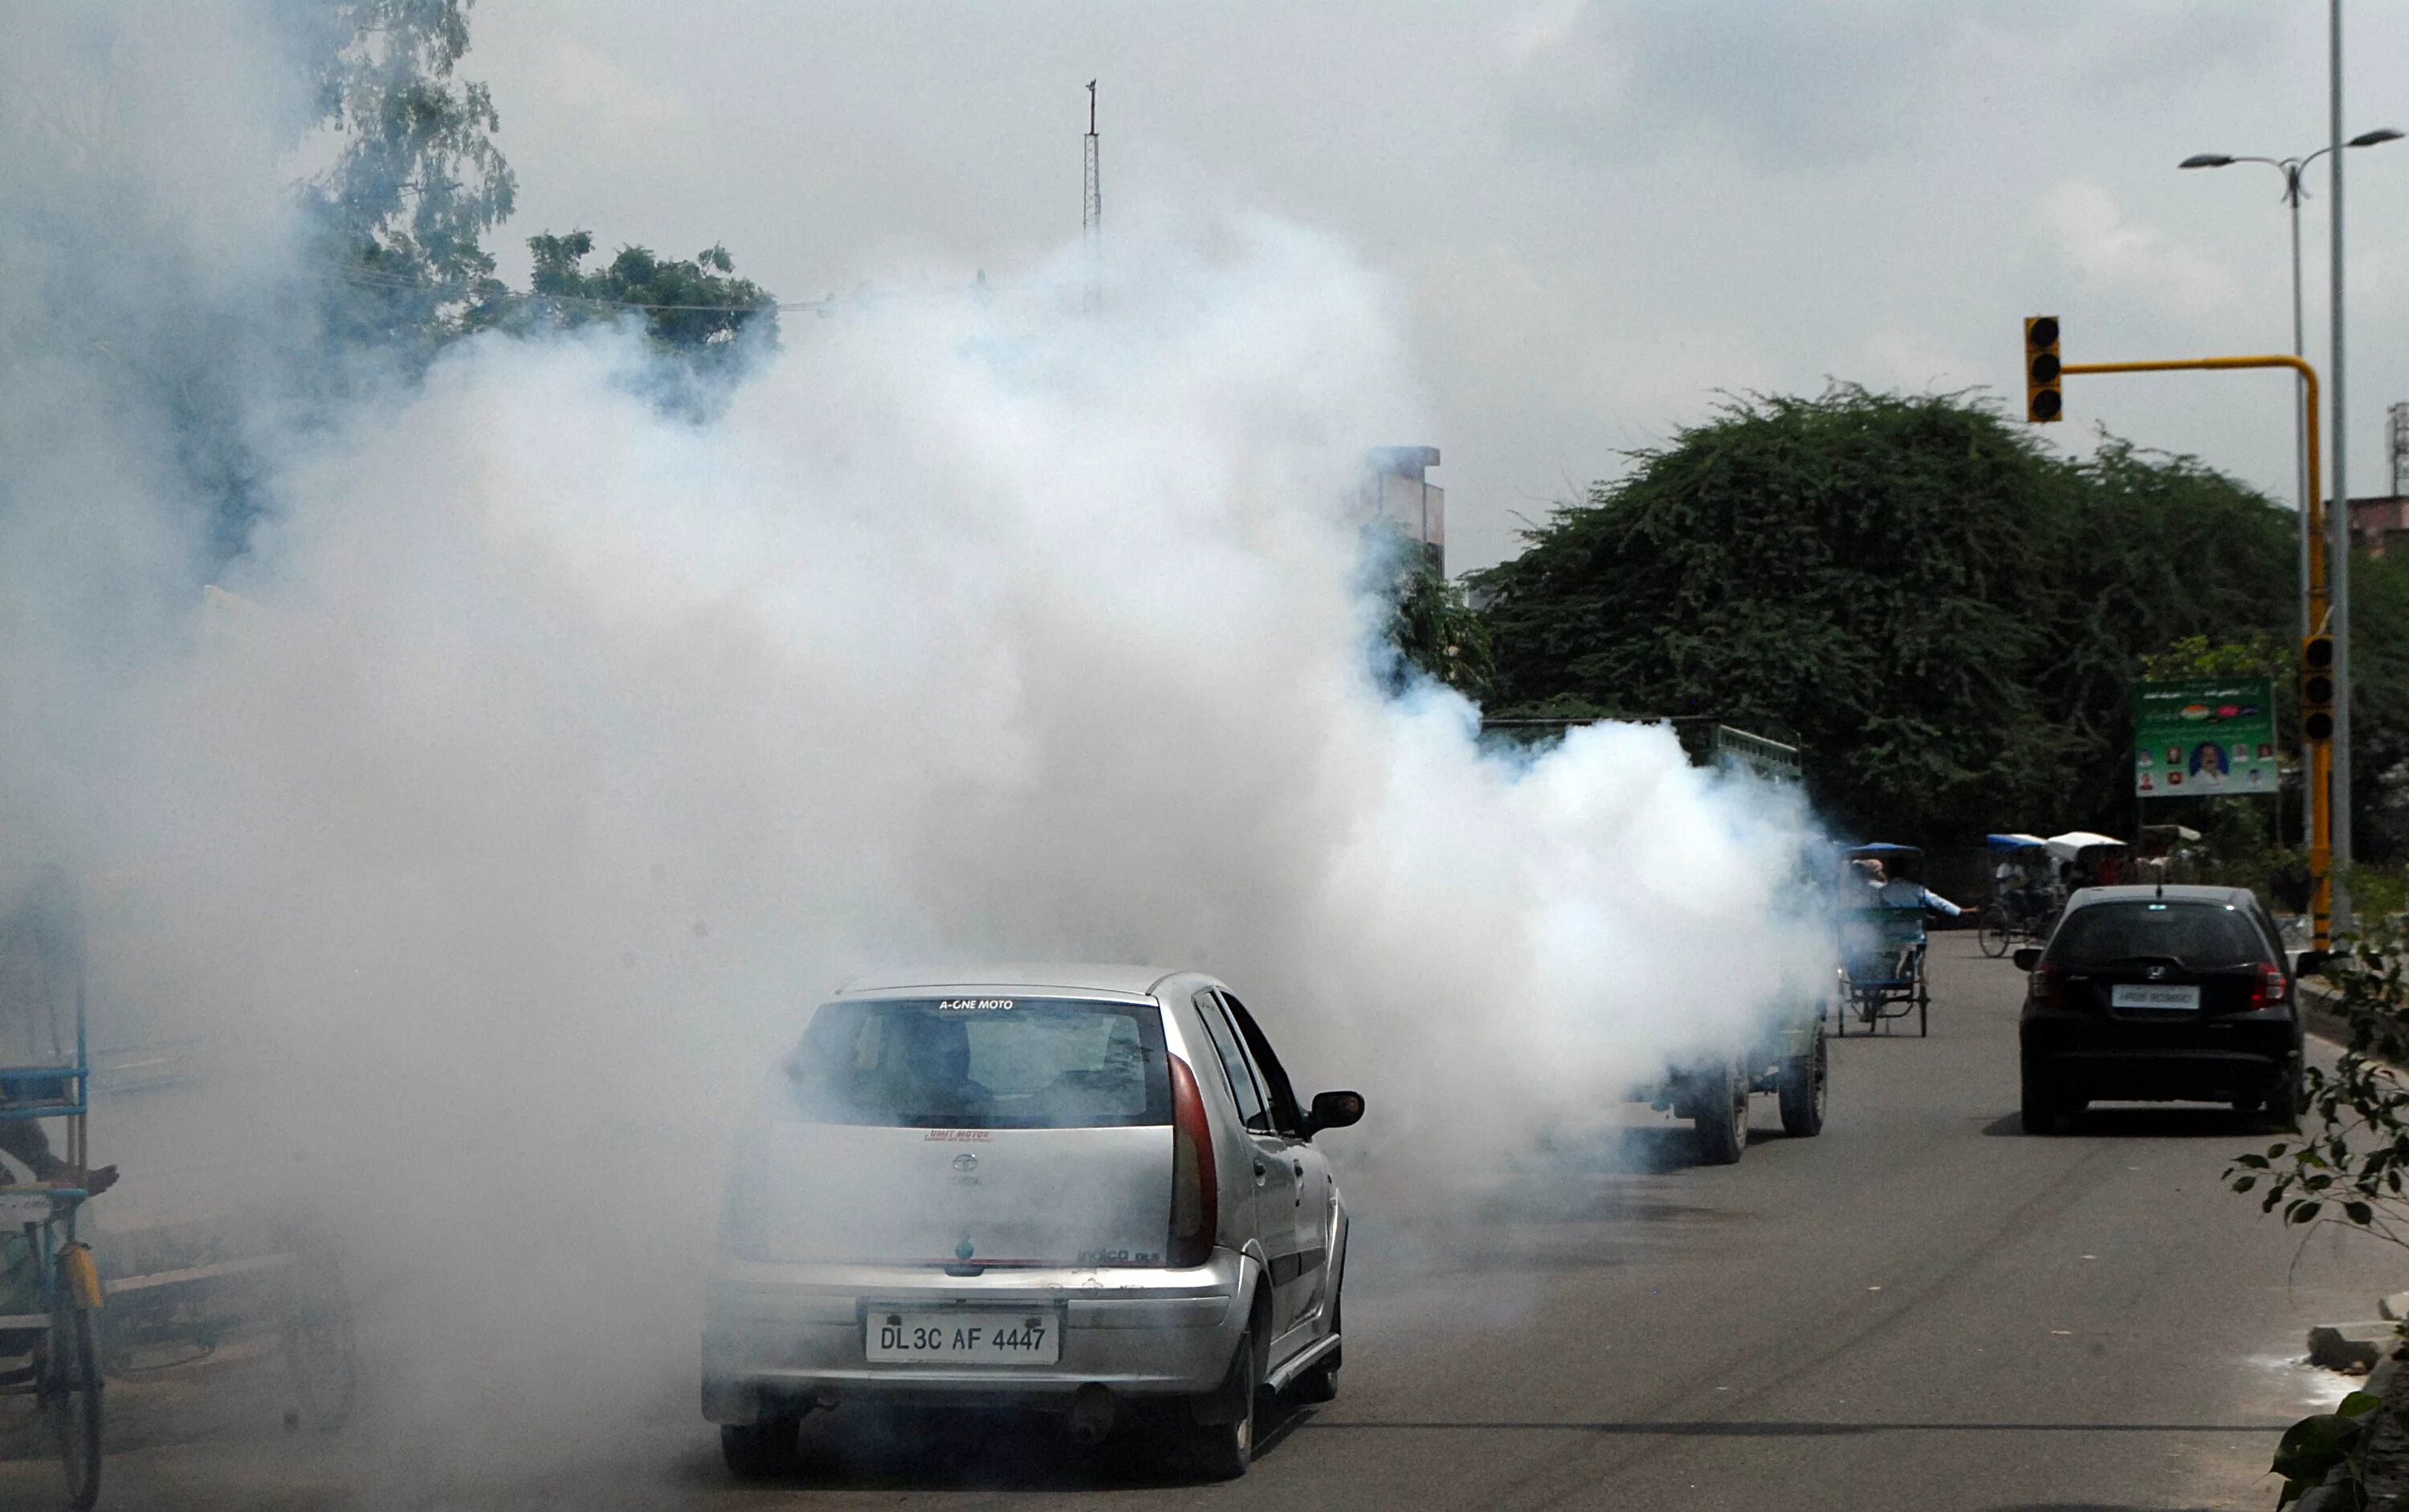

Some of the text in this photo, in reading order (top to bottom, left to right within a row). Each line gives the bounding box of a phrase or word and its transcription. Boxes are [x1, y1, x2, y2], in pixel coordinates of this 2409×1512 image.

[978, 1000, 1013, 1010] MOTO
[881, 1327, 1046, 1351] DL3C AF 4447
